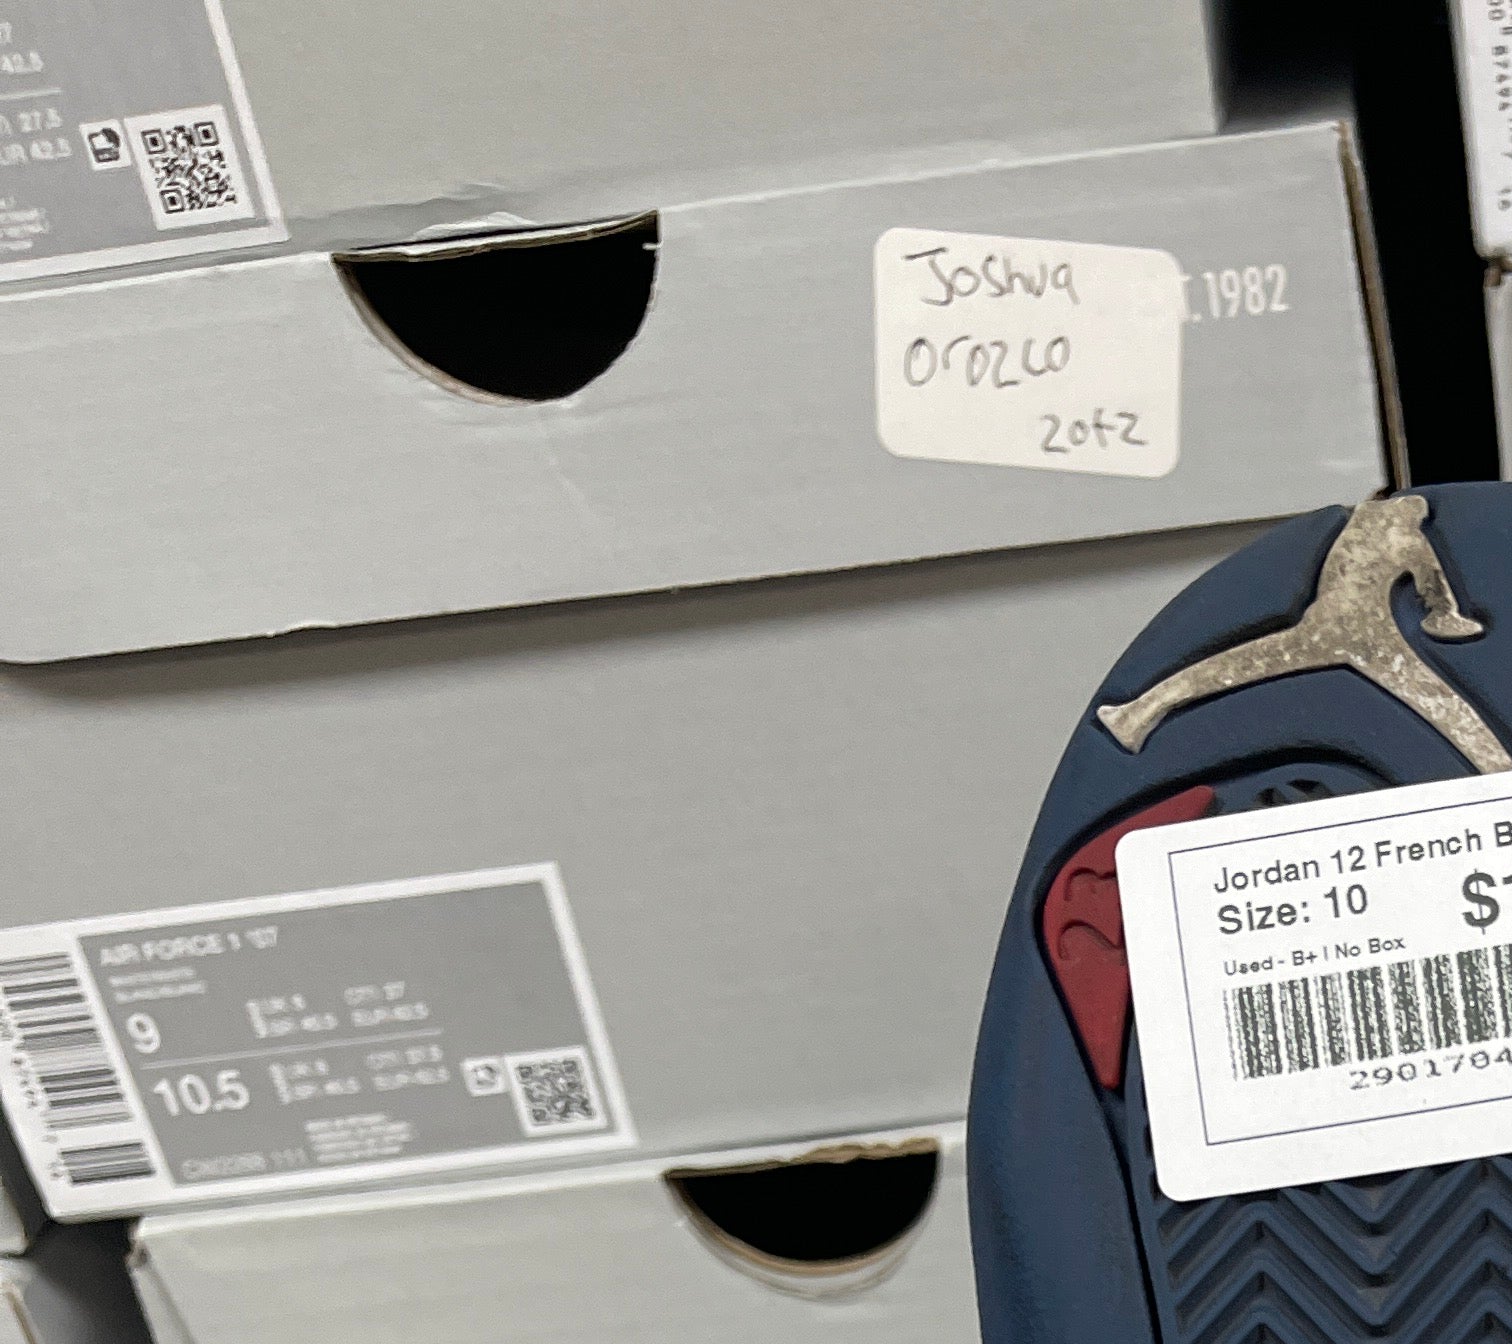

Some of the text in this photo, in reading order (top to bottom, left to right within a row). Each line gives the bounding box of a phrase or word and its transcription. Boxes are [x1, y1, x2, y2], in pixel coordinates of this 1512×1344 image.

[1214, 857, 1321, 894] Jordan
[1330, 844, 1367, 876] 12
[1374, 828, 1482, 868] French
[1217, 898, 1311, 935] Size:
[1322, 883, 1369, 919] 10
[1223, 955, 1274, 977] Used
[1292, 949, 1318, 967] B+
[1334, 942, 1362, 960] No
[1368, 936, 1406, 955] Box
[125, 1012, 161, 1054] 9
[152, 1068, 250, 1116] 10.5
